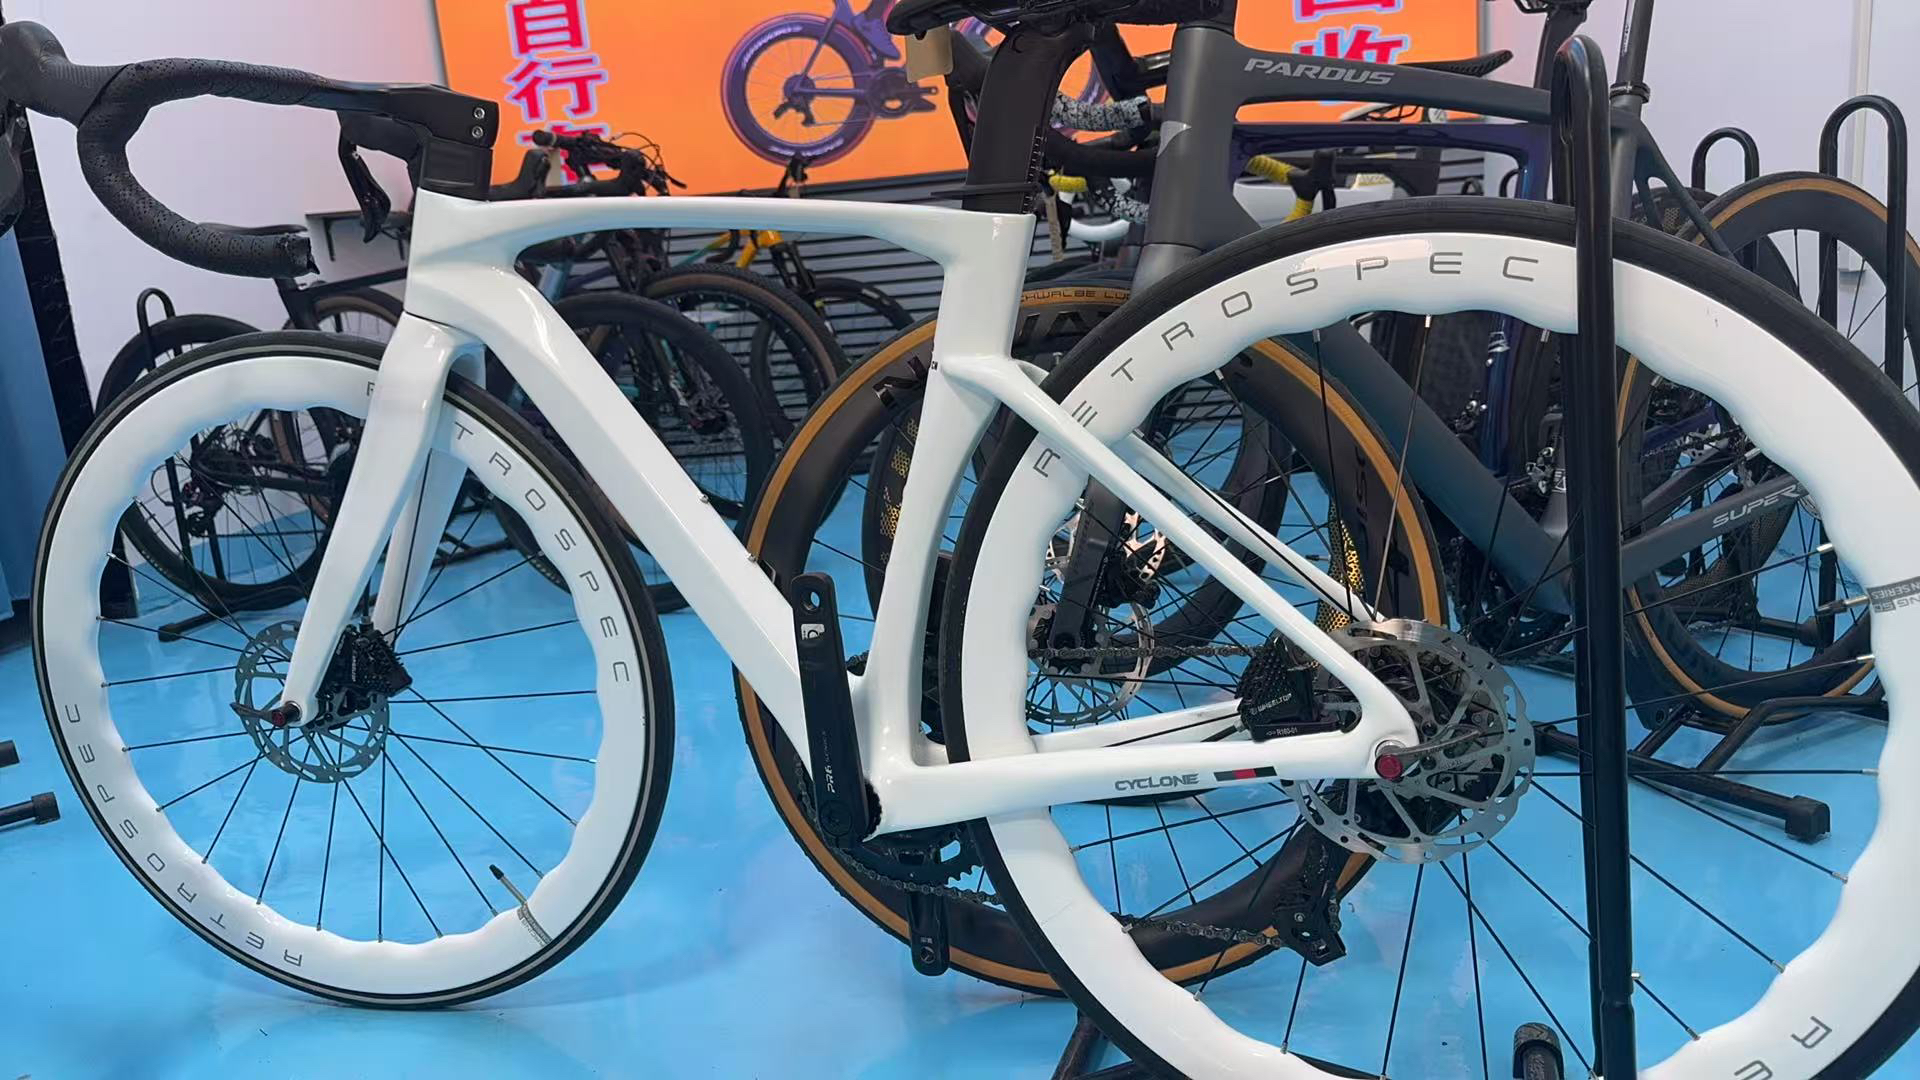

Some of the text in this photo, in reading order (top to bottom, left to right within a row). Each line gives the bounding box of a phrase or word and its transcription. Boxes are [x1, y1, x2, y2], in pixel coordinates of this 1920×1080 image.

[1244, 57, 1395, 85] PARDUS
[1712, 484, 1800, 529] SUPER
[366, 380, 631, 685] TROSPEC
[1114, 773, 1199, 791] CYCLONE
[65, 704, 303, 967] RETROSPEC
